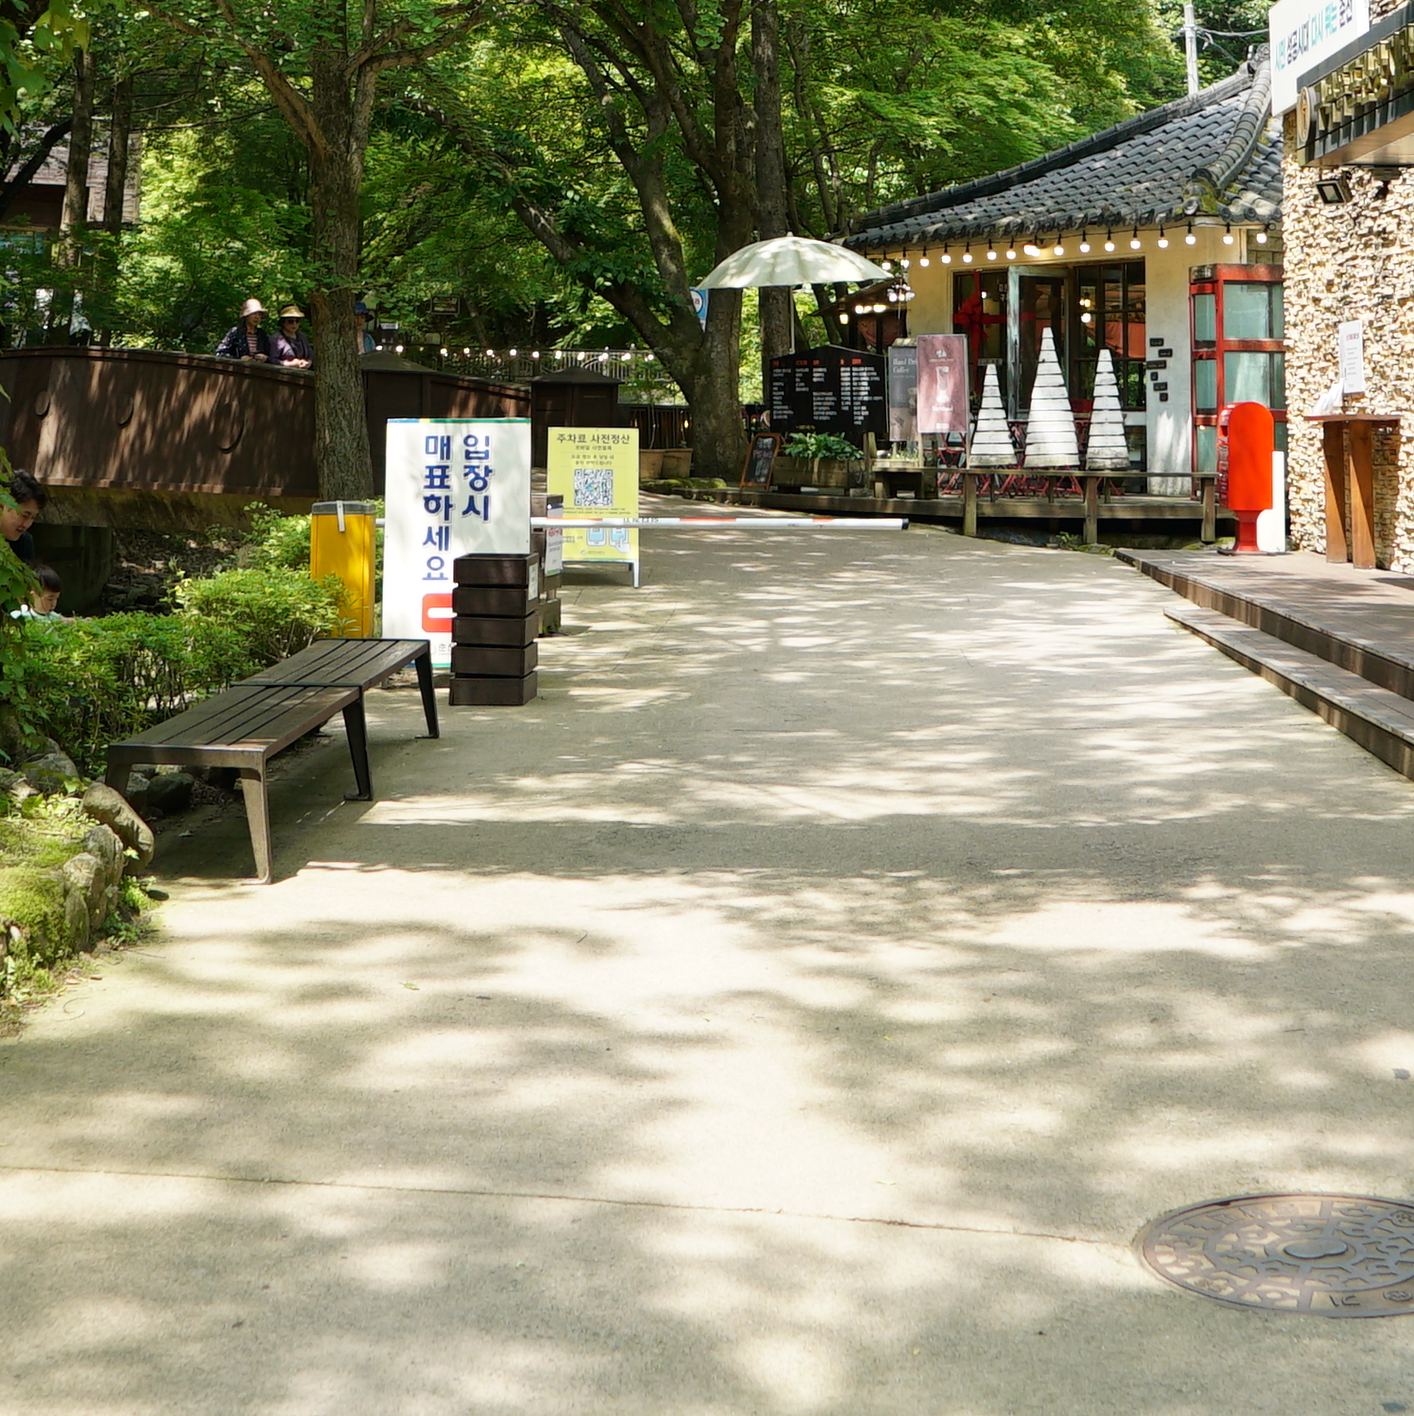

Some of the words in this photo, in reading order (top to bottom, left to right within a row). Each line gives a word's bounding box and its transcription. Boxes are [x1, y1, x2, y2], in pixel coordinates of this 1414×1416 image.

[462, 434, 493, 522] 입장시
[556, 433, 588, 444] 주차료
[590, 434, 630, 445] 사전정산
[421, 434, 453, 581] 매표하세요
